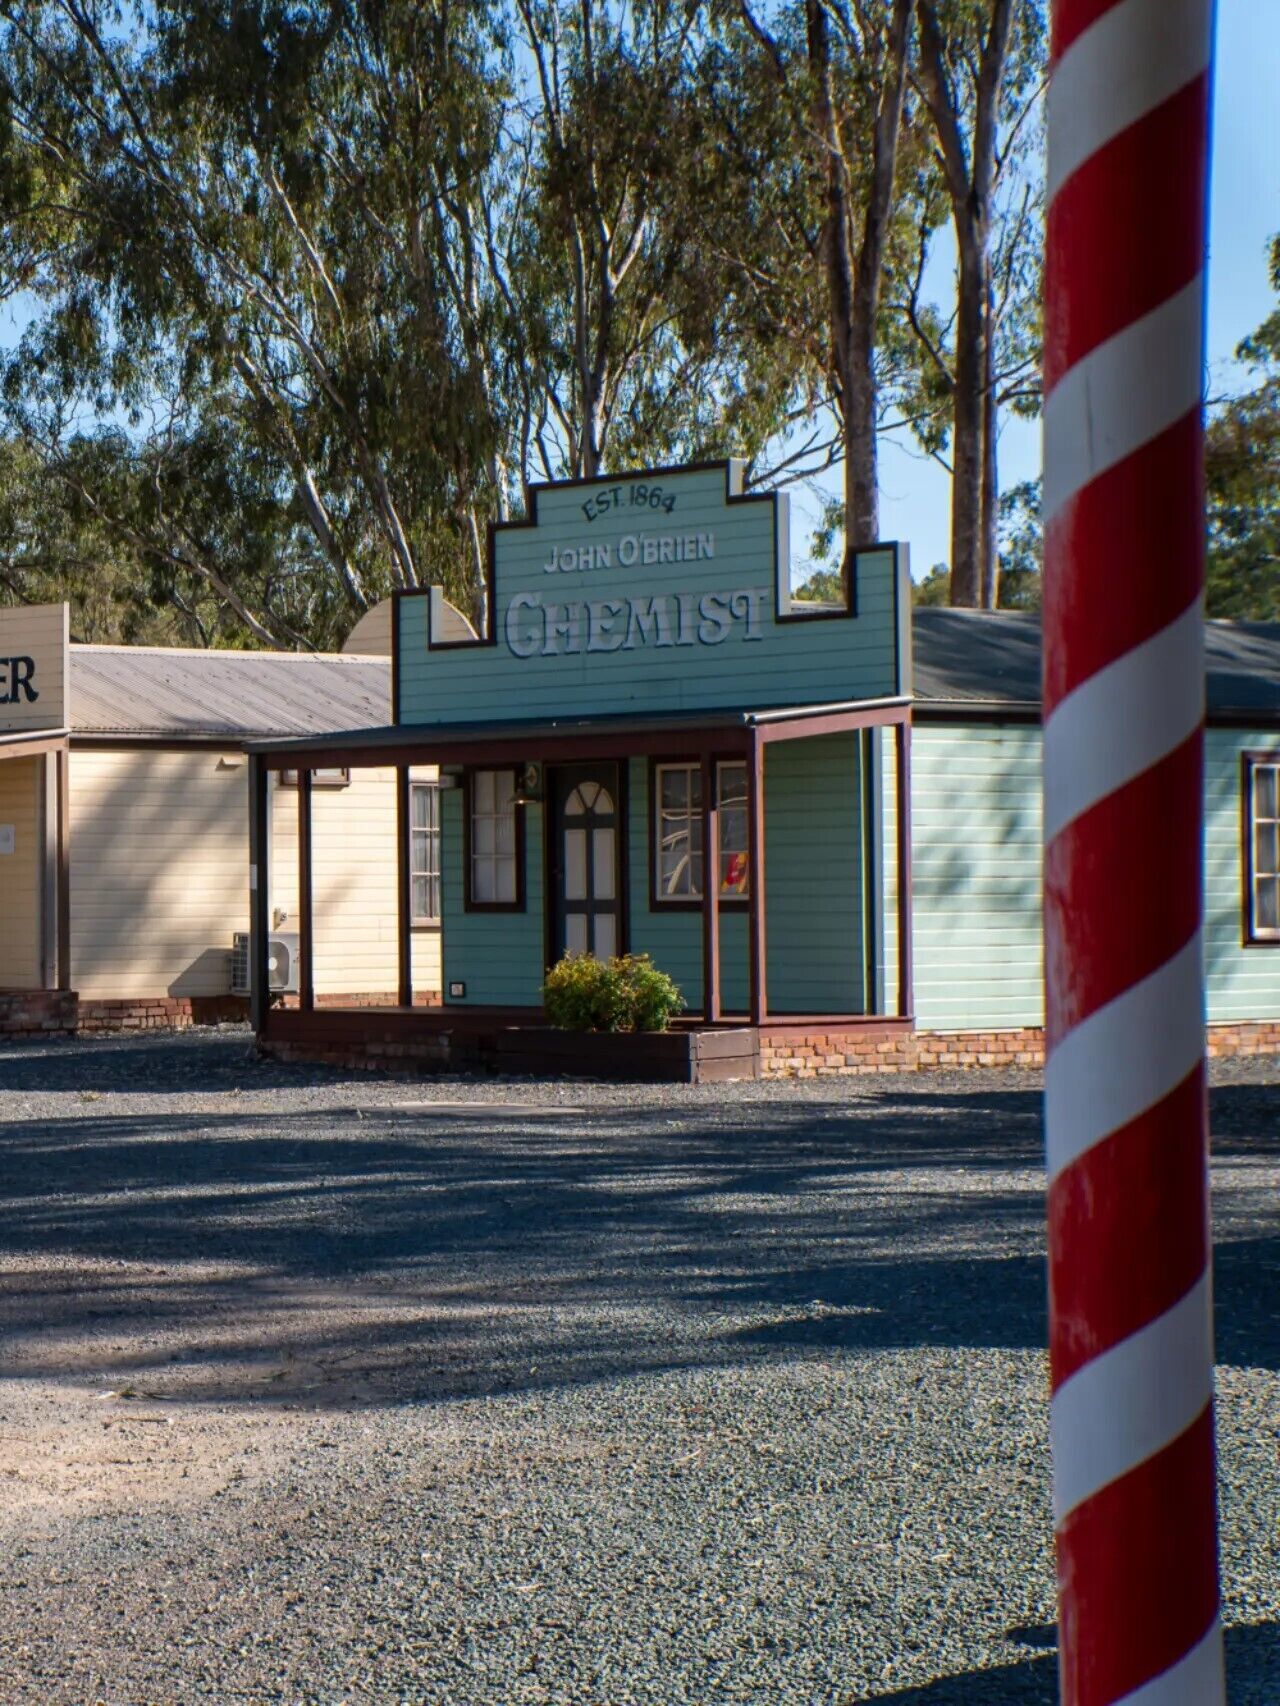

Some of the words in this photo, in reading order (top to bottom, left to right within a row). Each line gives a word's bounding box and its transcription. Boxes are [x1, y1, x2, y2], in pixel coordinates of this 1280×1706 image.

[630, 485, 676, 514] 1864
[544, 545, 611, 573] JOHN
[617, 533, 715, 567] O'BRIEN
[505, 588, 769, 659] CHEMIST
